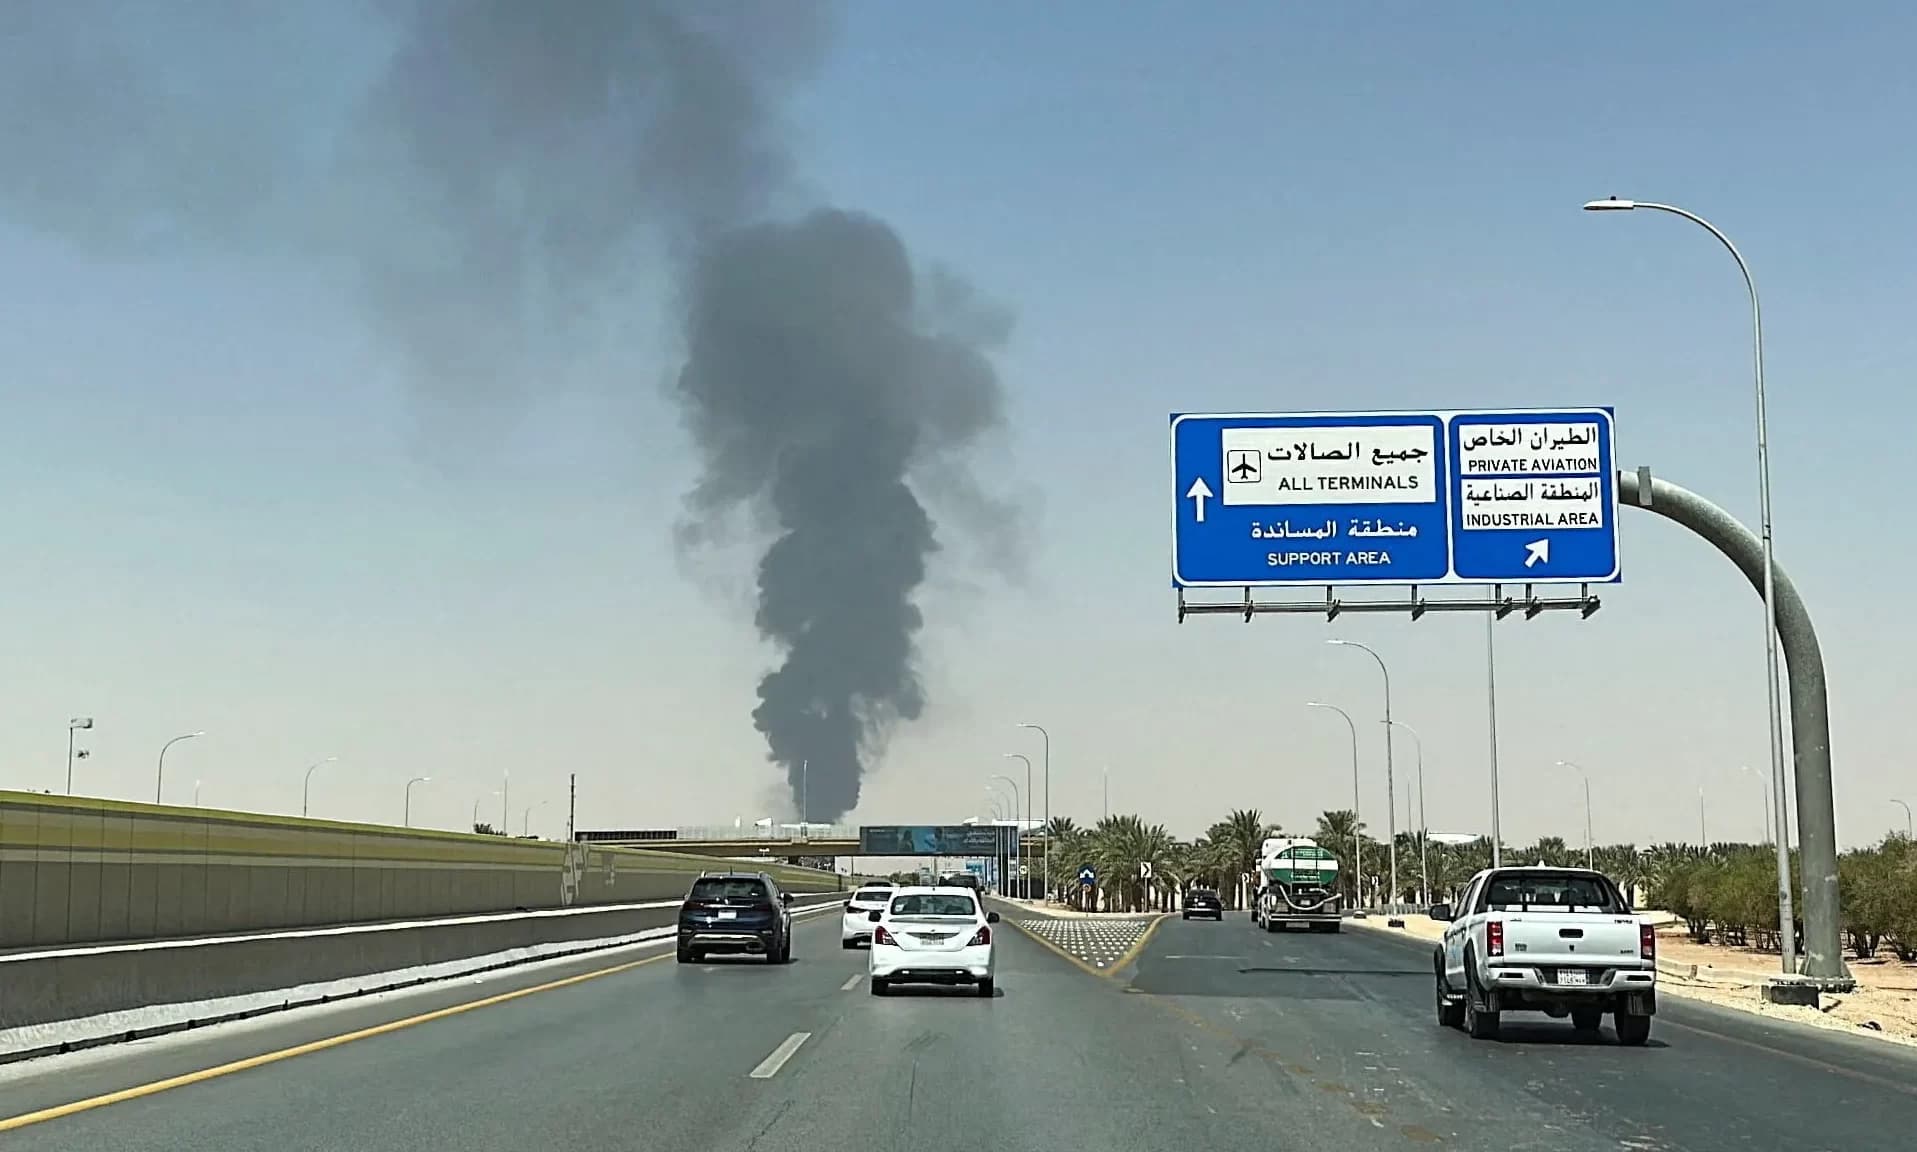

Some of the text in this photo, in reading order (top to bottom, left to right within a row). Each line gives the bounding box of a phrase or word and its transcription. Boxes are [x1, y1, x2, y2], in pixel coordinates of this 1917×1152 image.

[1463, 427, 1596, 451] الطيران الخاص
[1267, 441, 1428, 465] جميع الصالات
[1468, 457, 1597, 472] PRIVATE AVIATION
[1278, 476, 1419, 490] ALL TERMINALS
[1466, 481, 1598, 506] المنطقة الصناعية
[1466, 512, 1599, 526] INDUSTRIAL AREA
[1251, 518, 1418, 539] منطقة المساندة
[1267, 551, 1391, 566] SUPPORT AREA
